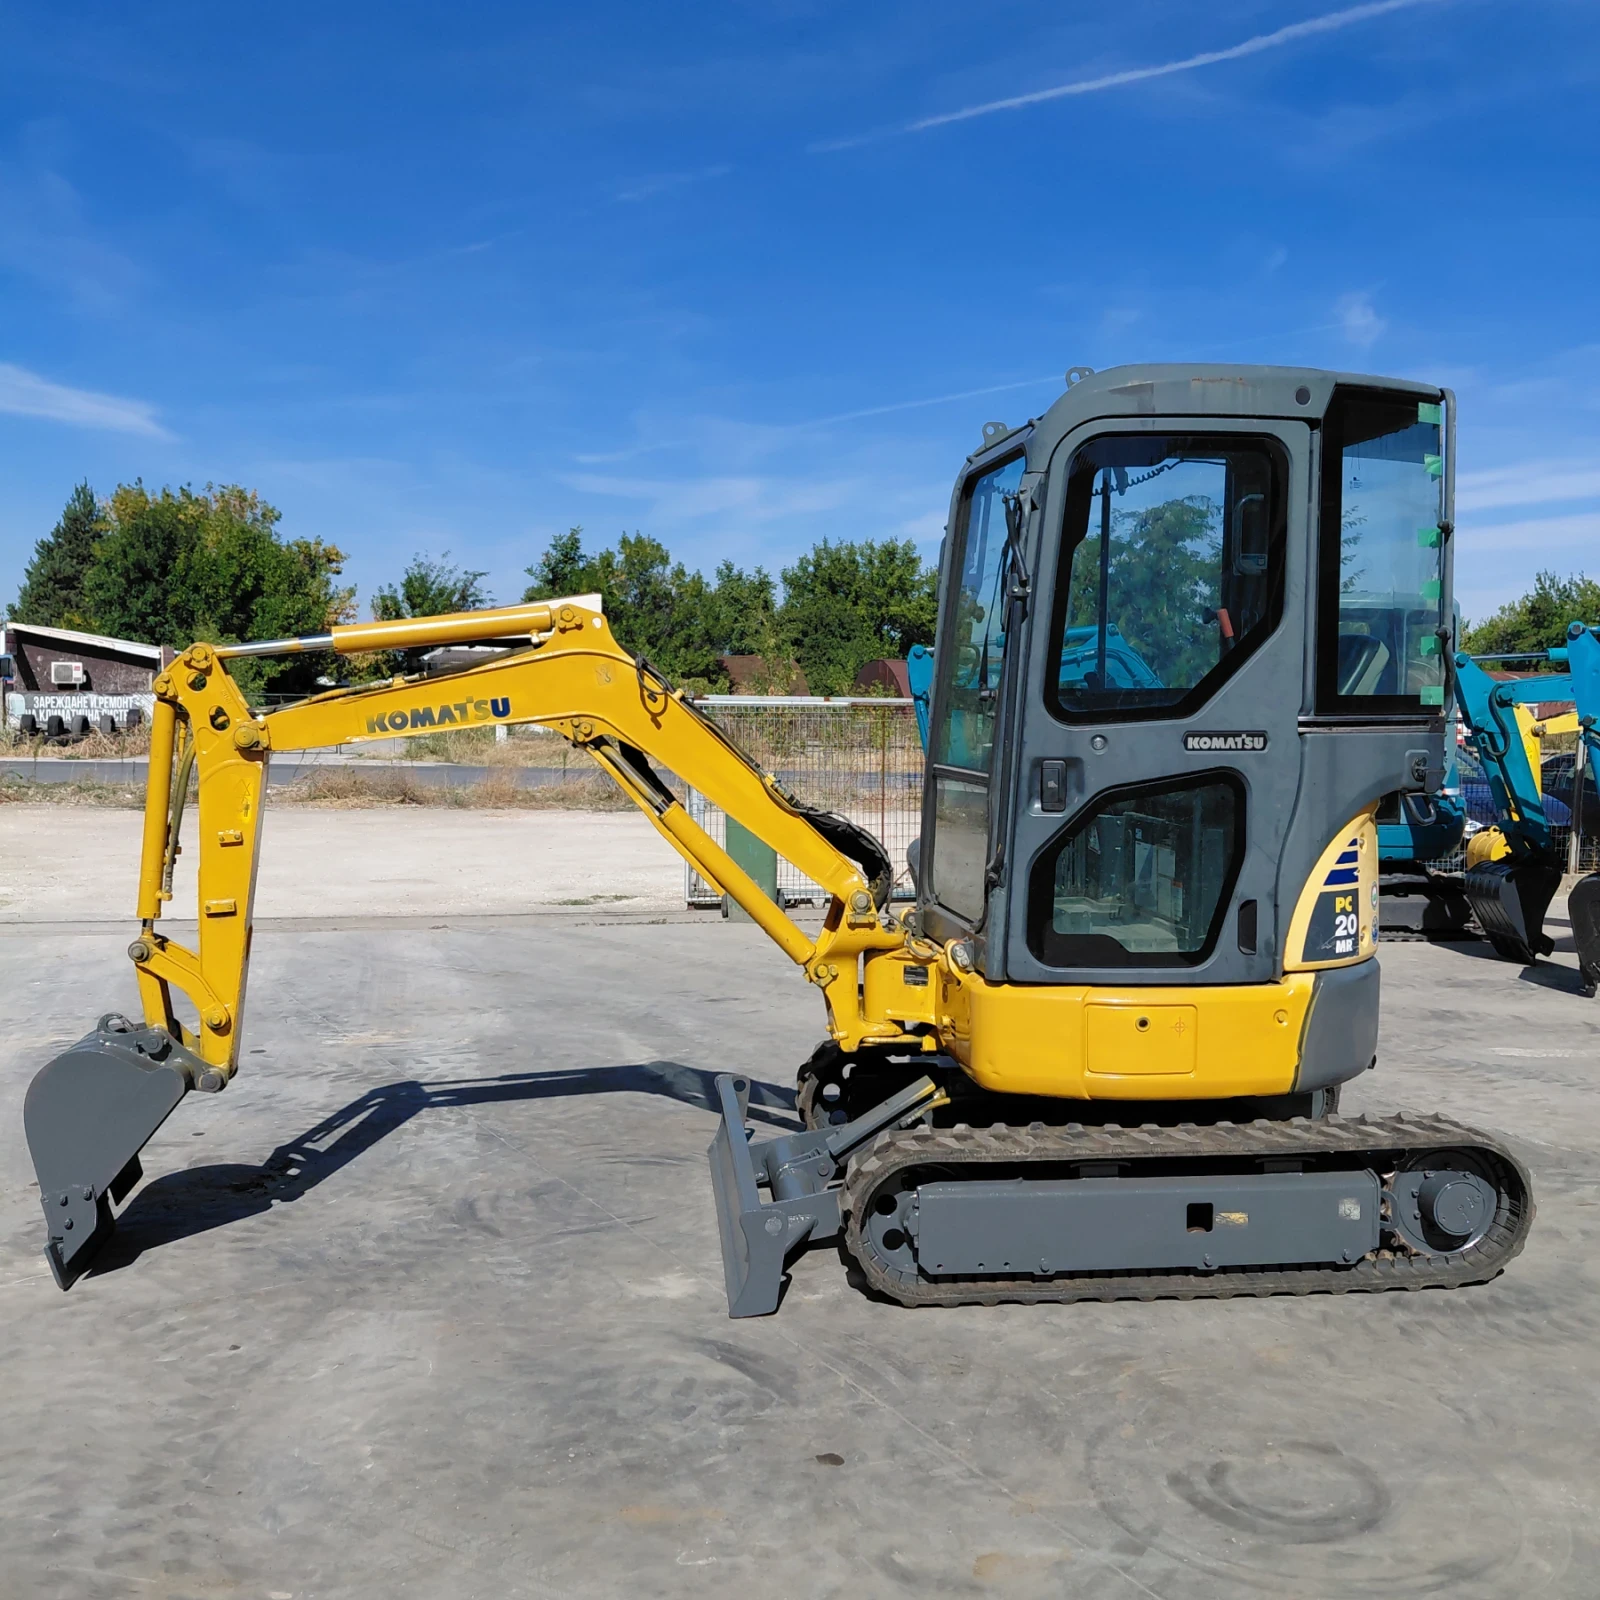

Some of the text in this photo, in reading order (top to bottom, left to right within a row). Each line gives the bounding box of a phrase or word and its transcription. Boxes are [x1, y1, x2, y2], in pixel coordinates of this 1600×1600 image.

[33, 696, 134, 709] ЗАРЕЖДАНЕ И РЕМОНТ
[102, 709, 129, 721] СИСТЕ
[366, 696, 511, 733] KOMATSU
[1187, 734, 1264, 749] KOMATSU
[1335, 896, 1352, 913] PC
[1335, 913, 1357, 936] 20
[1335, 938, 1354, 953] MR
